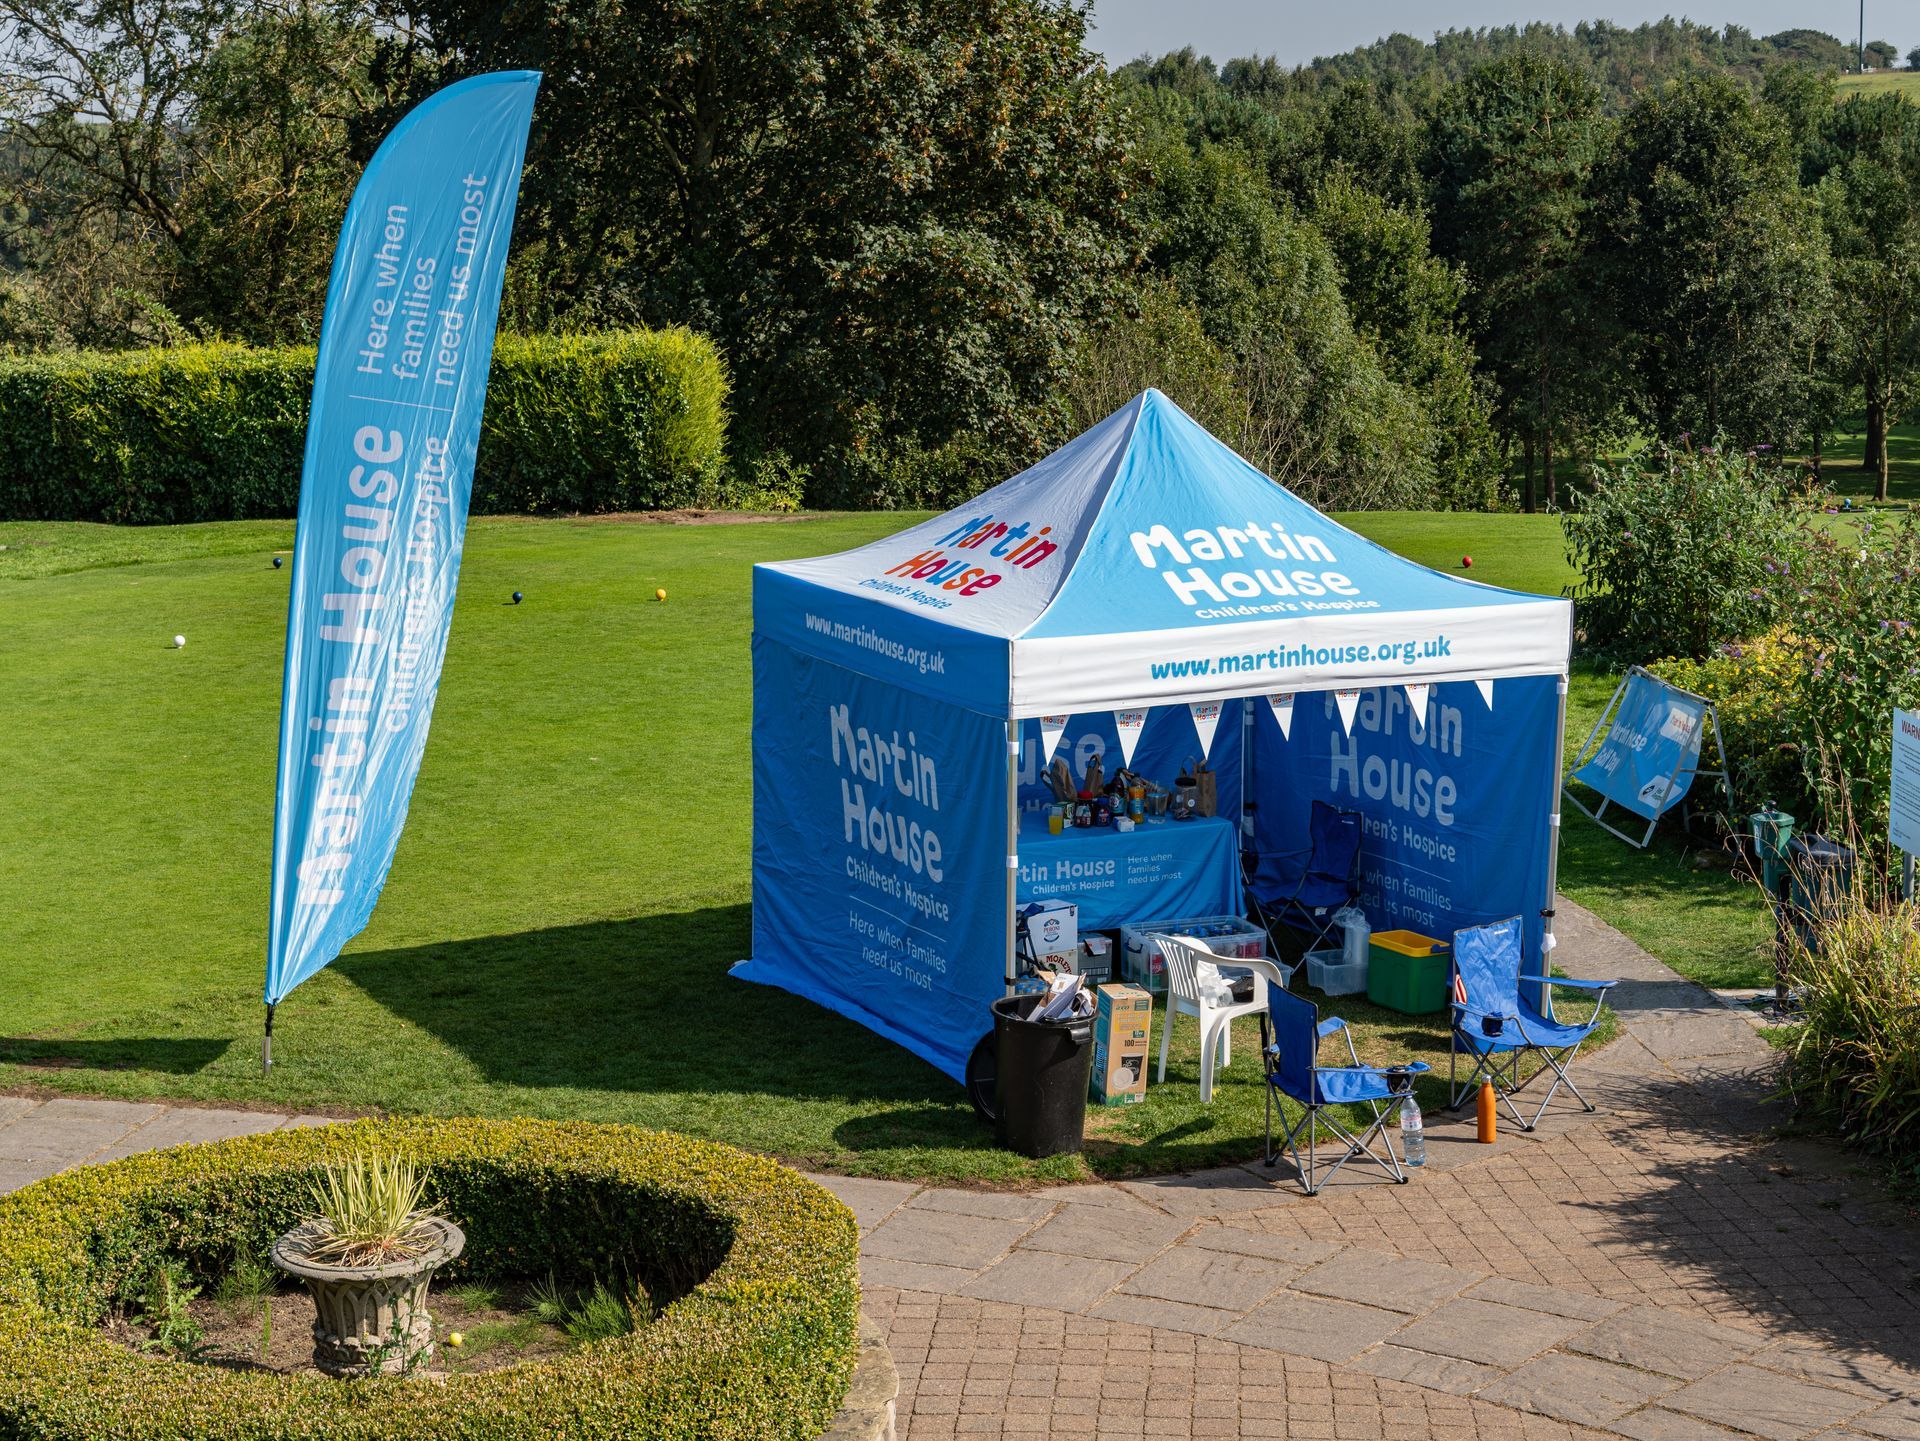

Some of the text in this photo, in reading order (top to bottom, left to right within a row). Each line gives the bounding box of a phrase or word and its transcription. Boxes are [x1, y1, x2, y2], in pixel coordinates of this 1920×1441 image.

[357, 205, 408, 374] Here when
[435, 173, 487, 386] need us most
[392, 257, 436, 379] families
[406, 437, 449, 564] Hospice
[934, 514, 1058, 569] Martin
[1129, 521, 1337, 568] Martin
[858, 578, 952, 610] Children's Hospice
[884, 550, 1002, 597] House
[1162, 567, 1360, 606] House
[1195, 598, 1381, 620] Children's Hospice
[296, 425, 404, 905] Martin House
[805, 612, 945, 674] www.martinhouse.org.uk
[1151, 635, 1451, 680] www.martinhouse.org.uk
[1119, 713, 1142, 721] Martin
[1195, 704, 1218, 715] Martin
[1901, 720, 1920, 741] WARN
[830, 703, 939, 811] Martin
[1330, 731, 1457, 826] House
[841, 777, 943, 883] House
[1403, 825, 1456, 863] Hospice
[1016, 859, 1115, 883] tin House
[1128, 852, 1173, 864] Here when
[1128, 875, 1148, 885] need
[1161, 871, 1183, 881] most
[846, 855, 949, 921] Children's Hospice
[1032, 879, 1115, 895] Children's Hospice
[1355, 890, 1380, 908] eed
[1403, 904, 1435, 928] most
[1366, 868, 1400, 892] when
[1403, 878, 1452, 911] families
[849, 910, 946, 974] Here when families
[1046, 954, 1072, 975] MORET
[862, 946, 933, 991] need us most
